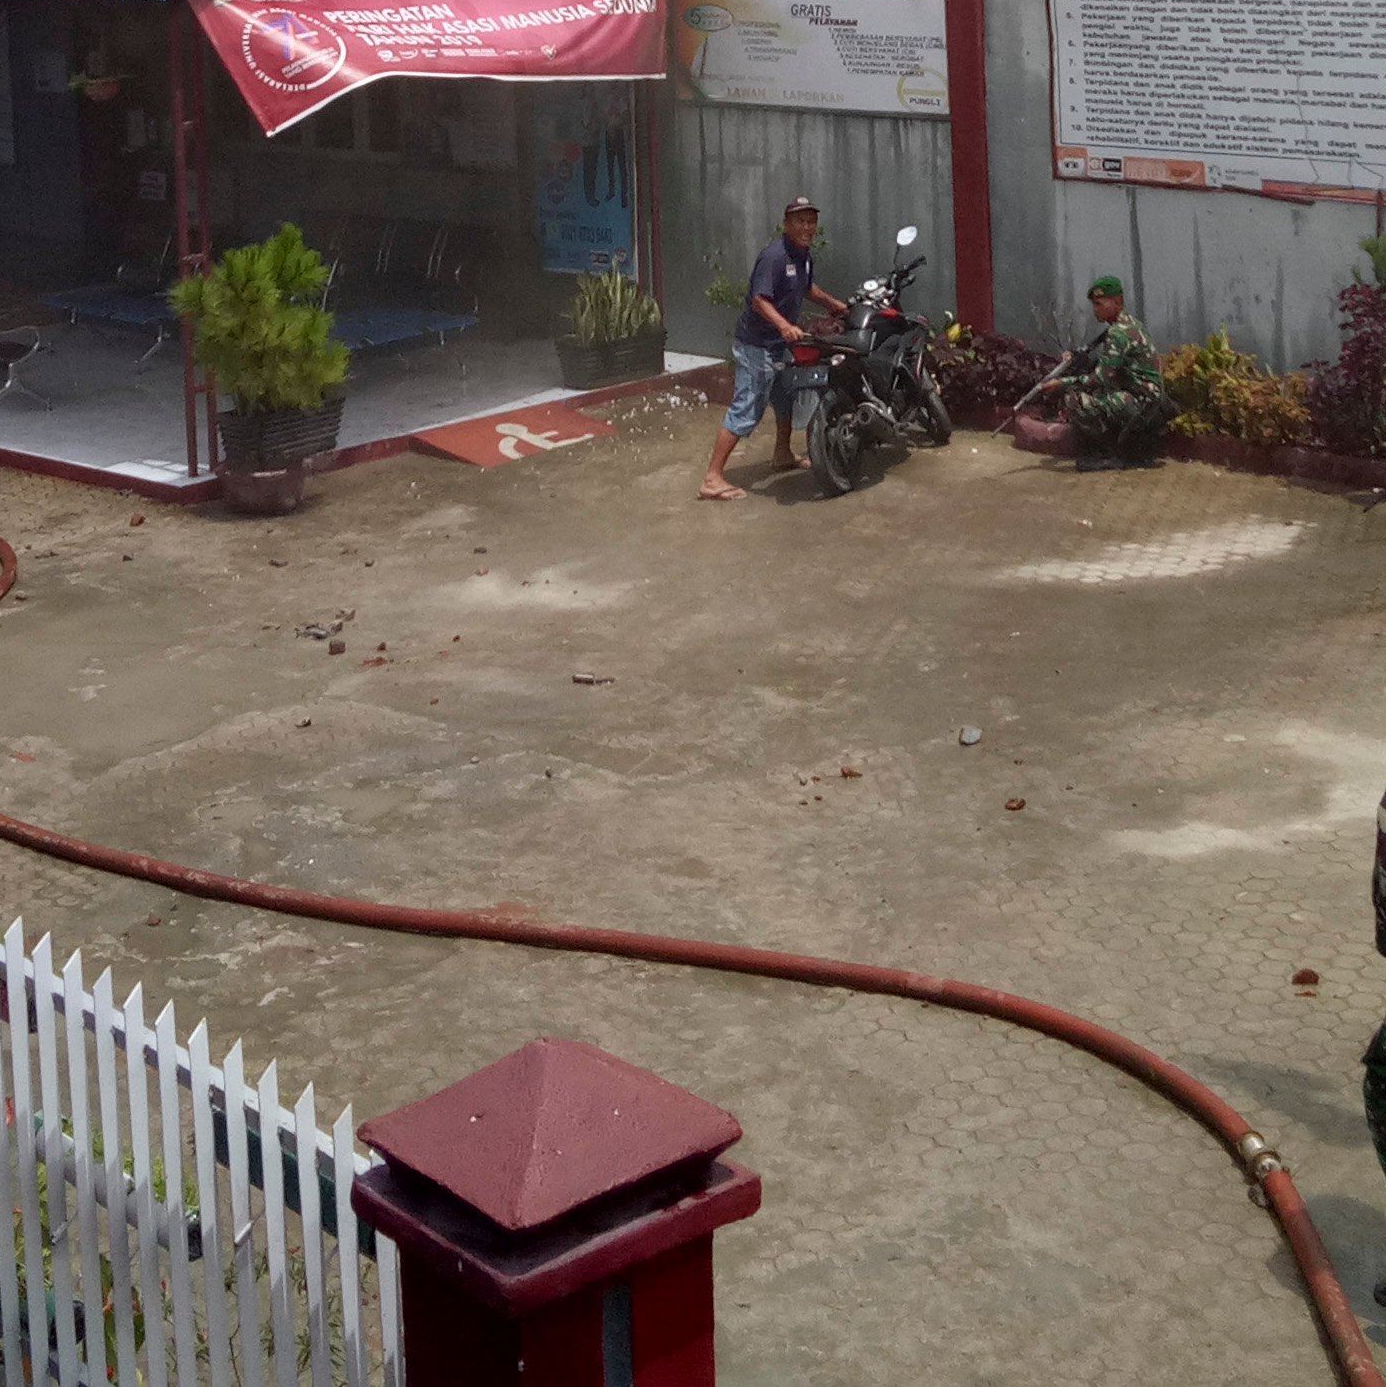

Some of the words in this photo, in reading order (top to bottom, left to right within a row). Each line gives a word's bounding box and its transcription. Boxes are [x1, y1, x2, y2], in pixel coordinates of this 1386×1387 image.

[324, 3, 455, 23] PERINGATAN
[791, 3, 831, 17] GRATIS
[443, 17, 500, 36] ASASI
[502, 4, 596, 30] MANUSIA
[433, 35, 484, 46] 2019
